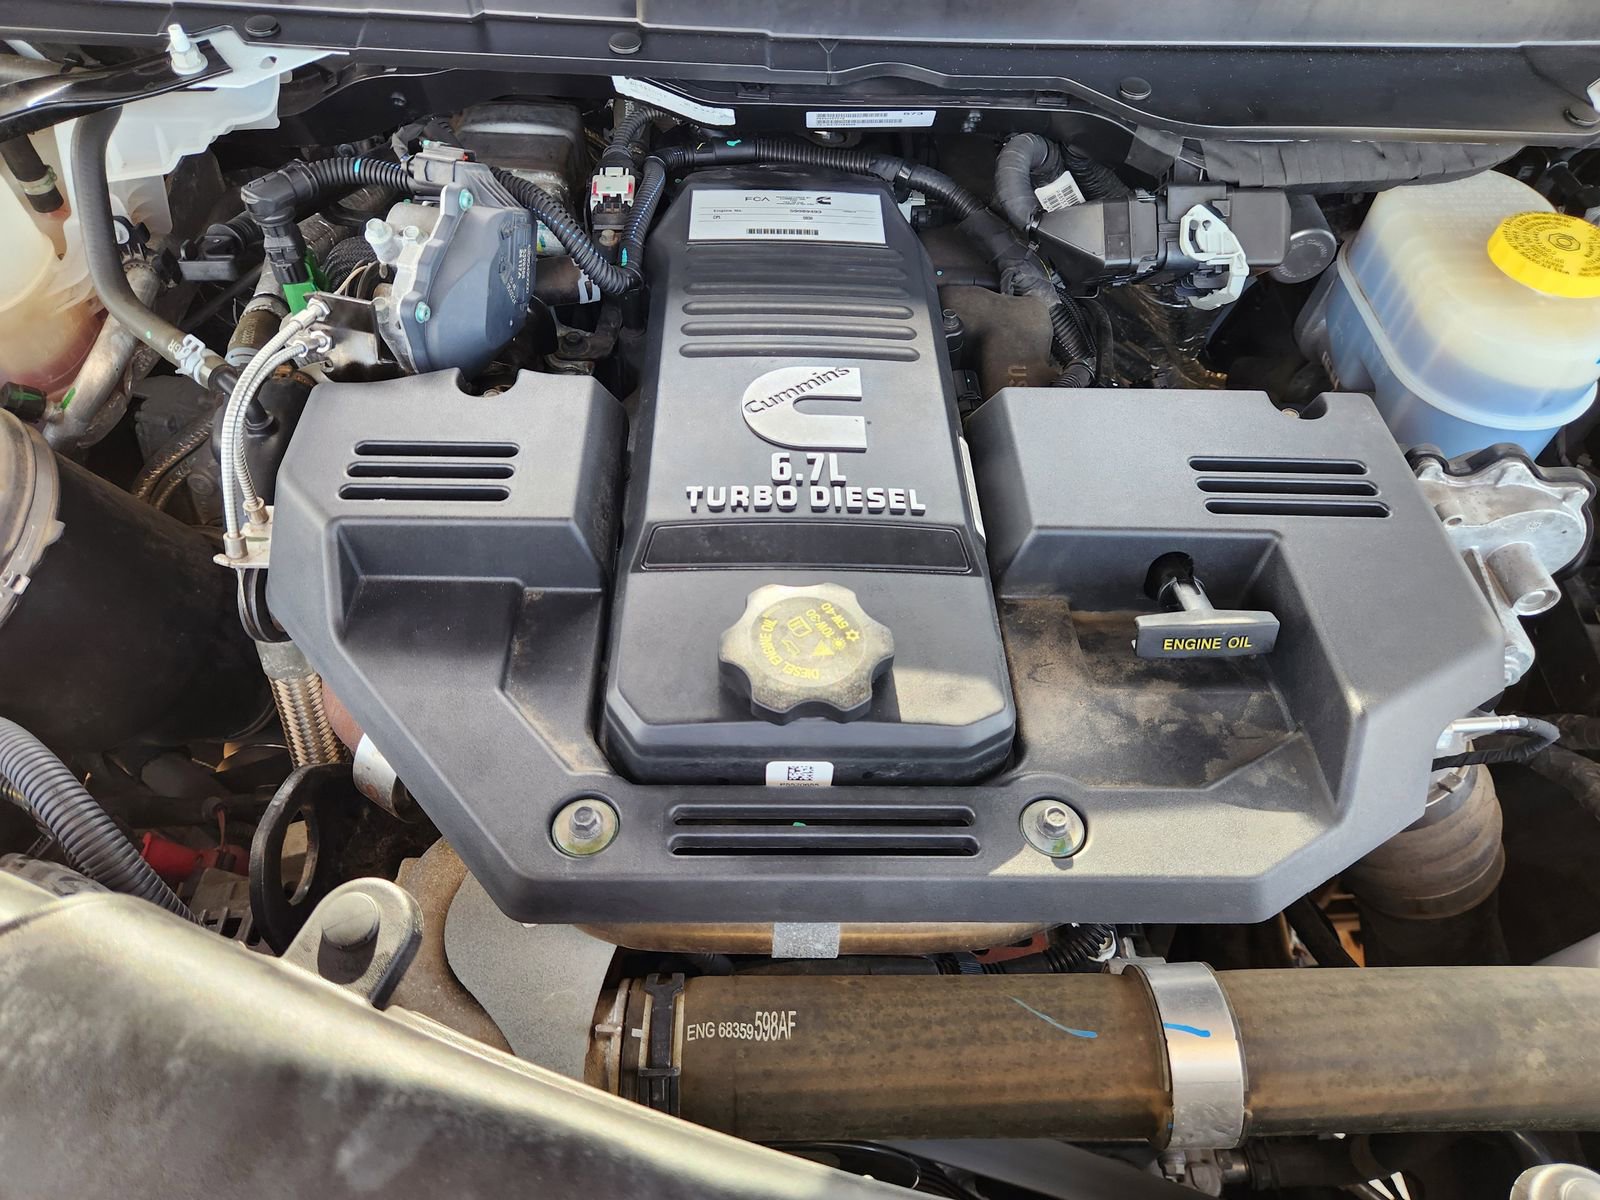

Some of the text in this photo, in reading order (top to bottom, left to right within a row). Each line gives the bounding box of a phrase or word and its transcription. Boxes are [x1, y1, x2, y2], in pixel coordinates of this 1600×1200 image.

[743, 366, 851, 415] Cummins
[771, 452, 847, 487] 6.7L
[686, 485, 926, 516] TURBO DIESEL
[806, 608, 835, 638] 10W-30
[821, 602, 849, 630] 5W-40
[759, 619, 821, 680] DIESEL ENGINE OIL
[1163, 636, 1253, 651] ENGINE OIL
[686, 1021, 716, 1041] ENG
